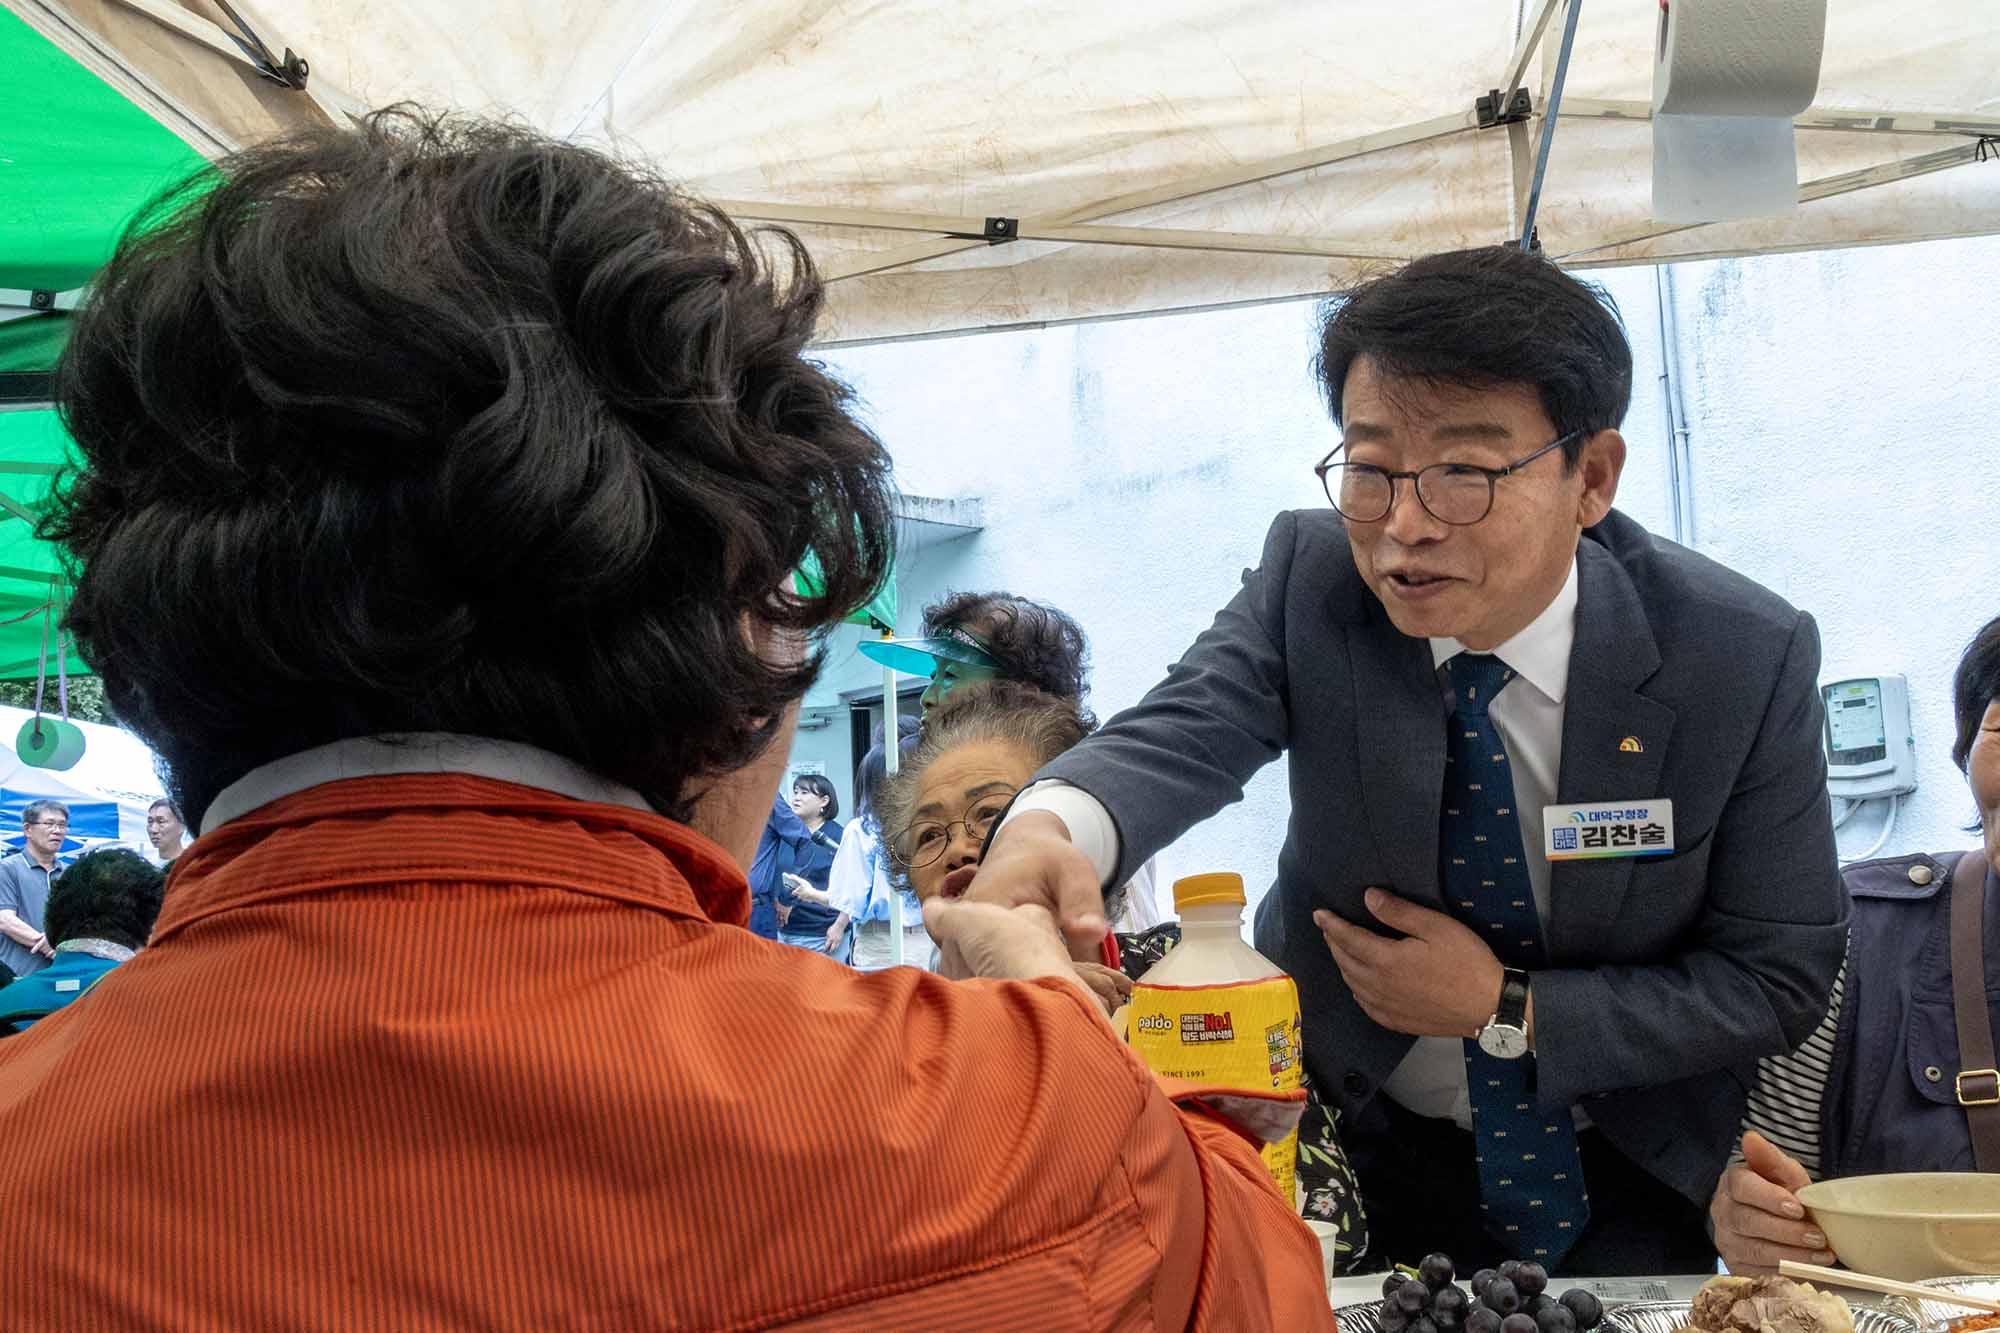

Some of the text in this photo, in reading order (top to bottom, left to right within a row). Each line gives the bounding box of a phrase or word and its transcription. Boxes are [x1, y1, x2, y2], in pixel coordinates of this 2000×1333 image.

[1588, 808, 1649, 822] 대덕구청장
[1582, 823, 1666, 848] 김찬술
[1138, 1014, 1172, 1032] paldo
[1182, 1031, 1199, 1041] 팔도
